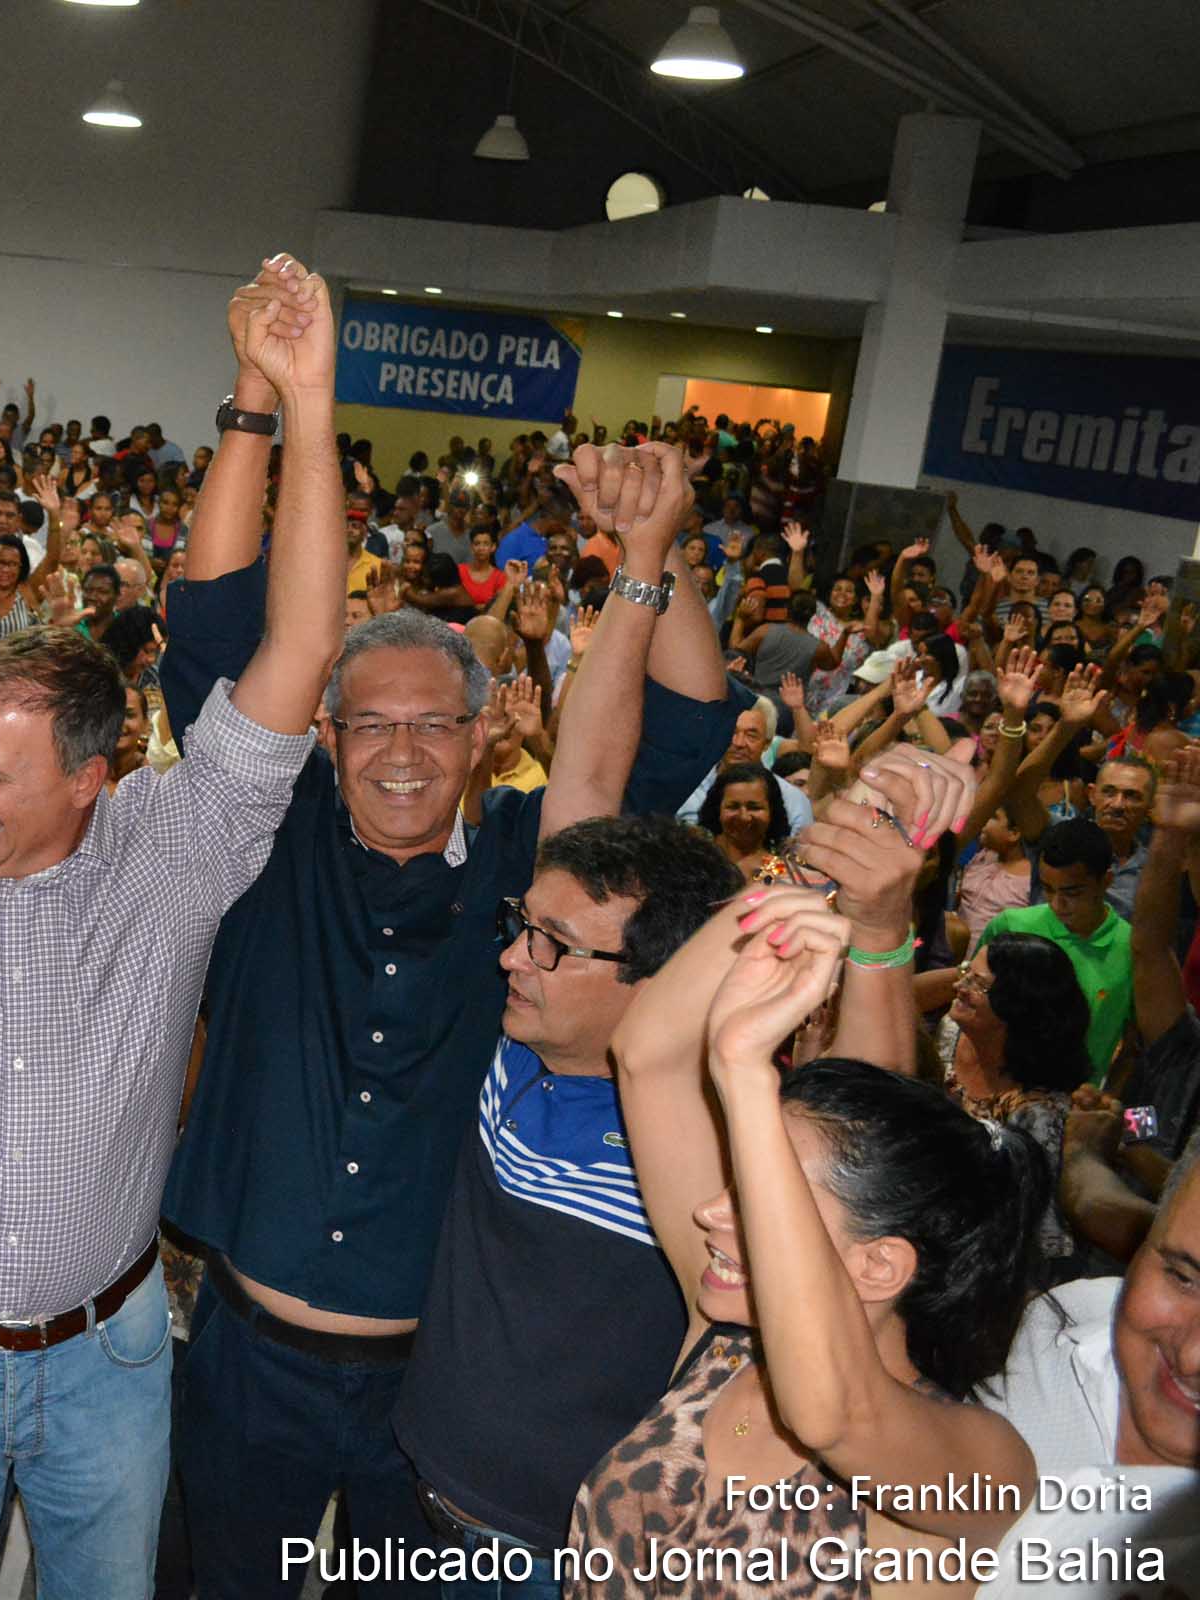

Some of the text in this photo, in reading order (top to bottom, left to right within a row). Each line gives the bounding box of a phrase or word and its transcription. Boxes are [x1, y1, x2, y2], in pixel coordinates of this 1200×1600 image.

[343, 320, 561, 371] OBRIGADO PELA
[378, 361, 514, 410] PRESENÇA
[961, 376, 1200, 484] Eremita
